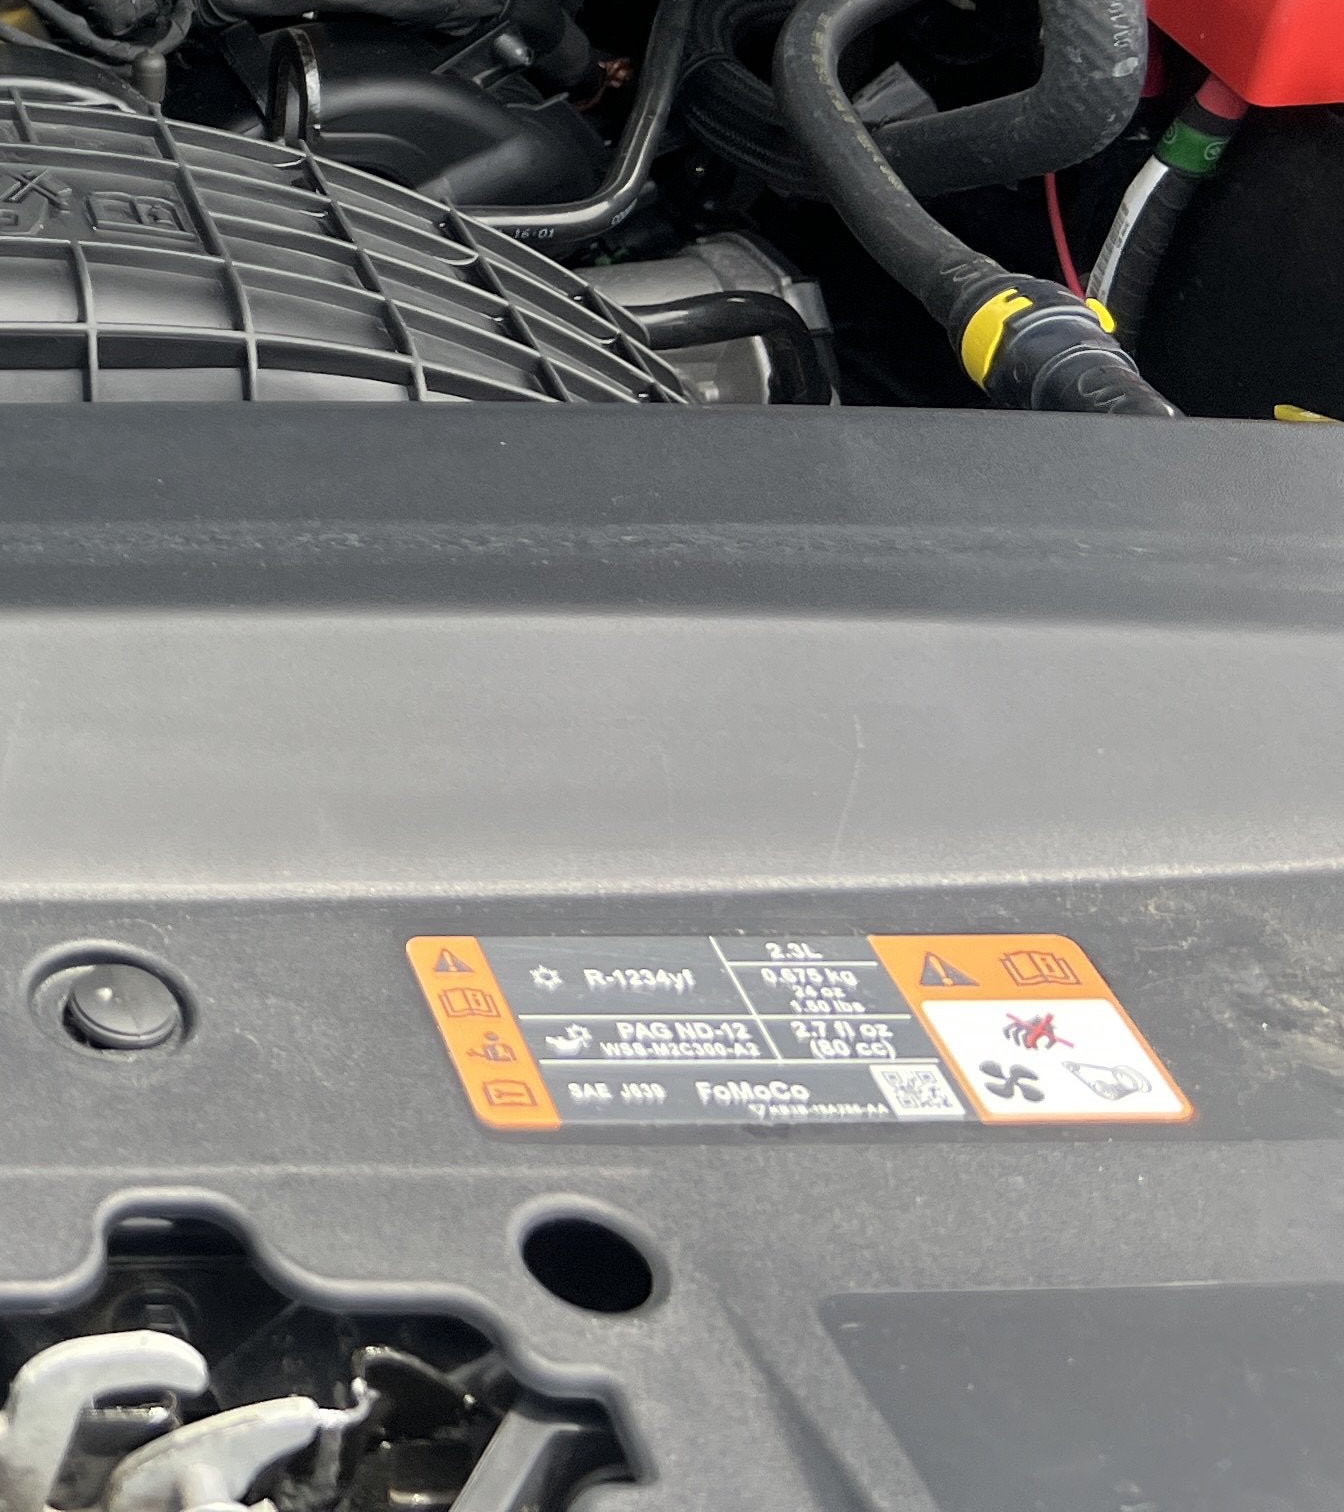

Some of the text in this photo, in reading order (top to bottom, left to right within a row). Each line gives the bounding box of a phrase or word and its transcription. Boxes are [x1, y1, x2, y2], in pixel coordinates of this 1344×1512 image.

[765, 942, 824, 960] 2.3L
[583, 968, 696, 994] R-1234yf
[761, 968, 824, 986] 0.675
[615, 1021, 753, 1041] PAG ND-12
[790, 1020, 827, 1039] 2.7
[859, 1023, 894, 1039] oz
[810, 1038, 897, 1061] (80 cc)
[568, 1082, 613, 1100] SAE
[695, 1080, 811, 1103] FoMoCo
